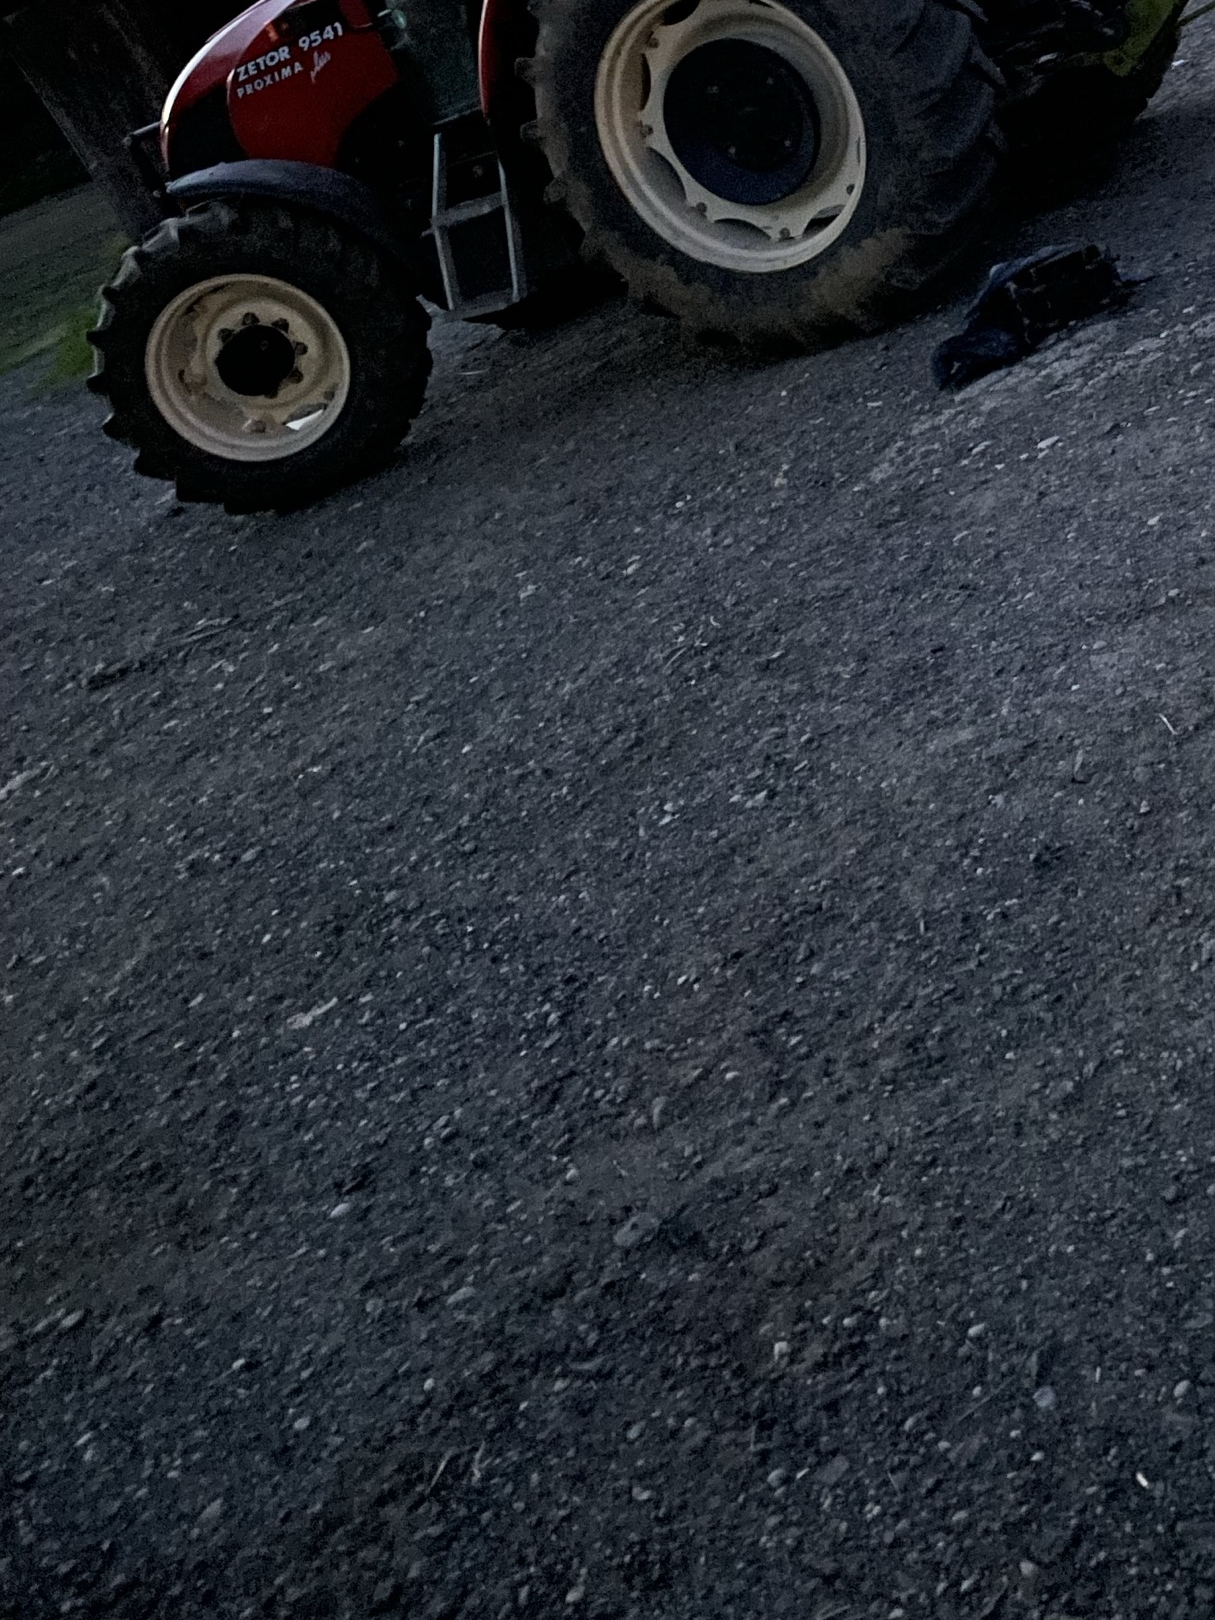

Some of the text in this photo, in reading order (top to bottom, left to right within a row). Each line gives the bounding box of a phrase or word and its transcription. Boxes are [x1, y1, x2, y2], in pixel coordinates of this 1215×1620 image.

[236, 21, 343, 82] ZETOR 9541
[236, 61, 304, 99] PROXIMA
